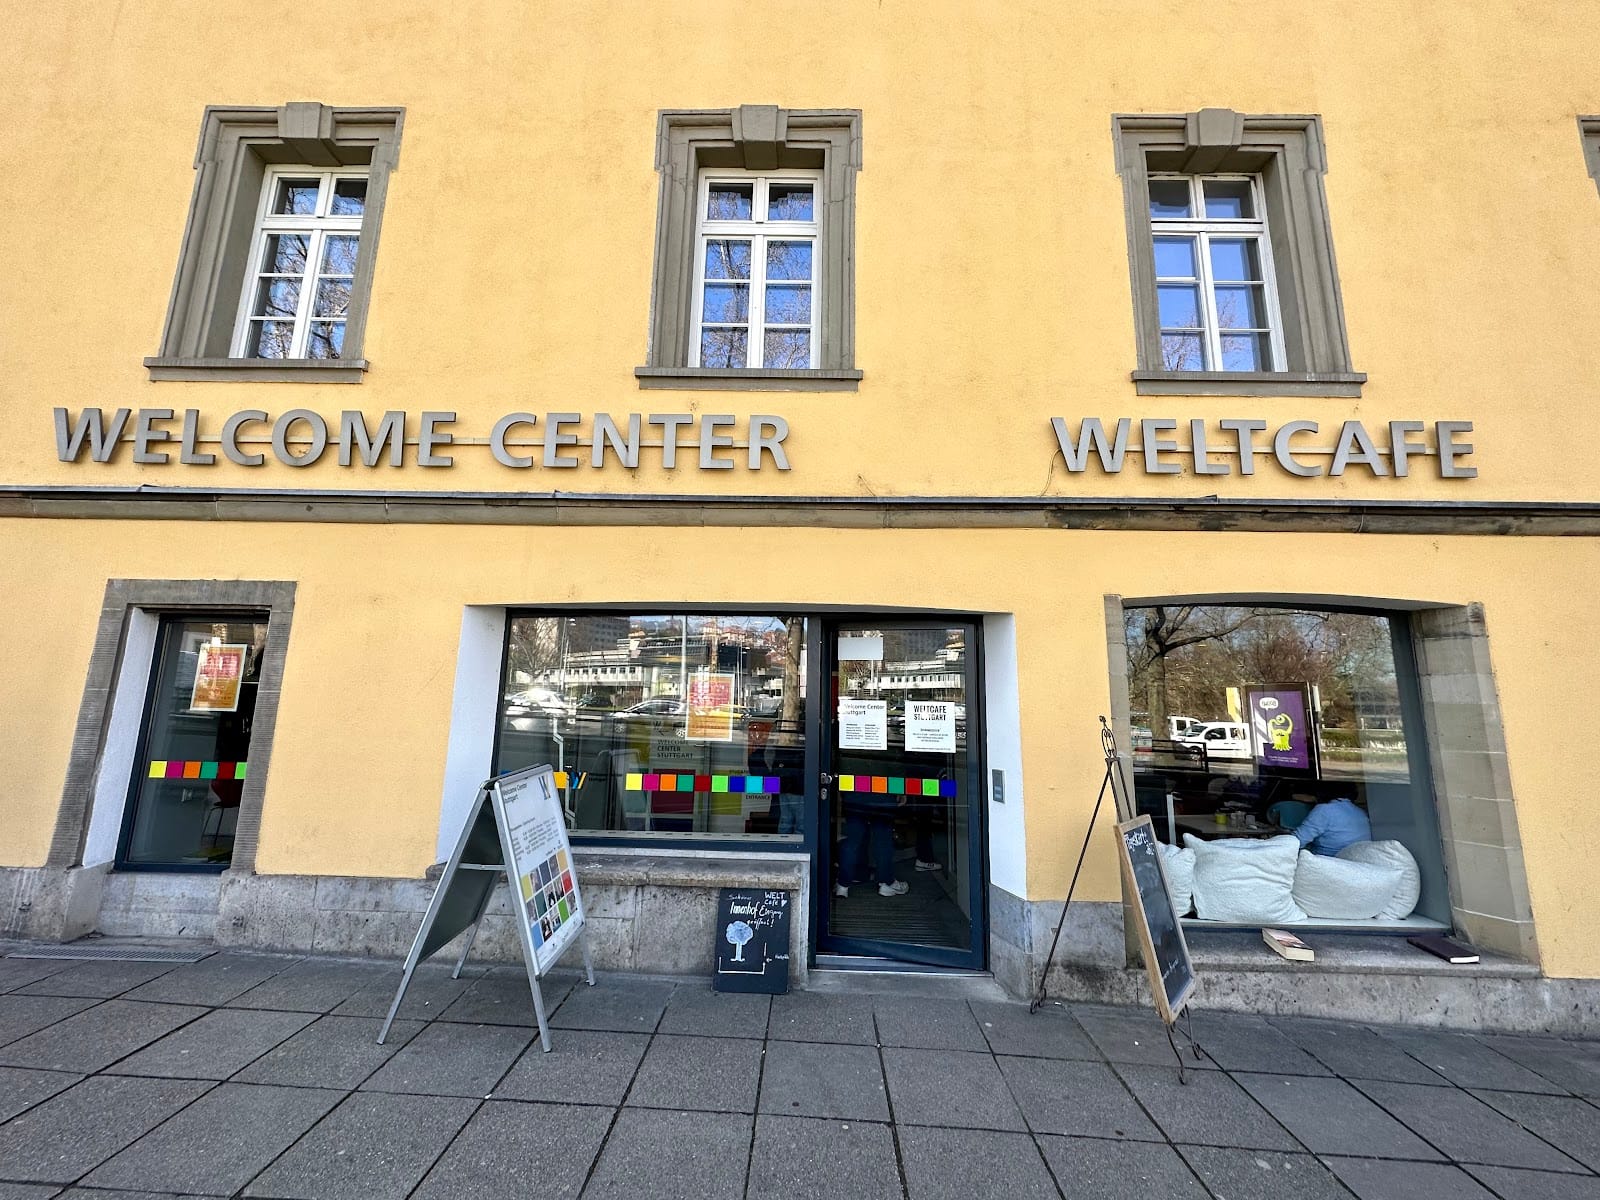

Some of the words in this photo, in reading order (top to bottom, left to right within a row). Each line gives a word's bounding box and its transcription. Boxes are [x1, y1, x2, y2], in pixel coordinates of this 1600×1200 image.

[53, 407, 457, 468] WELCOME
[490, 412, 792, 471] CENTER
[1050, 417, 1479, 478] WELTCAFE
[764, 891, 785, 900] WELT
